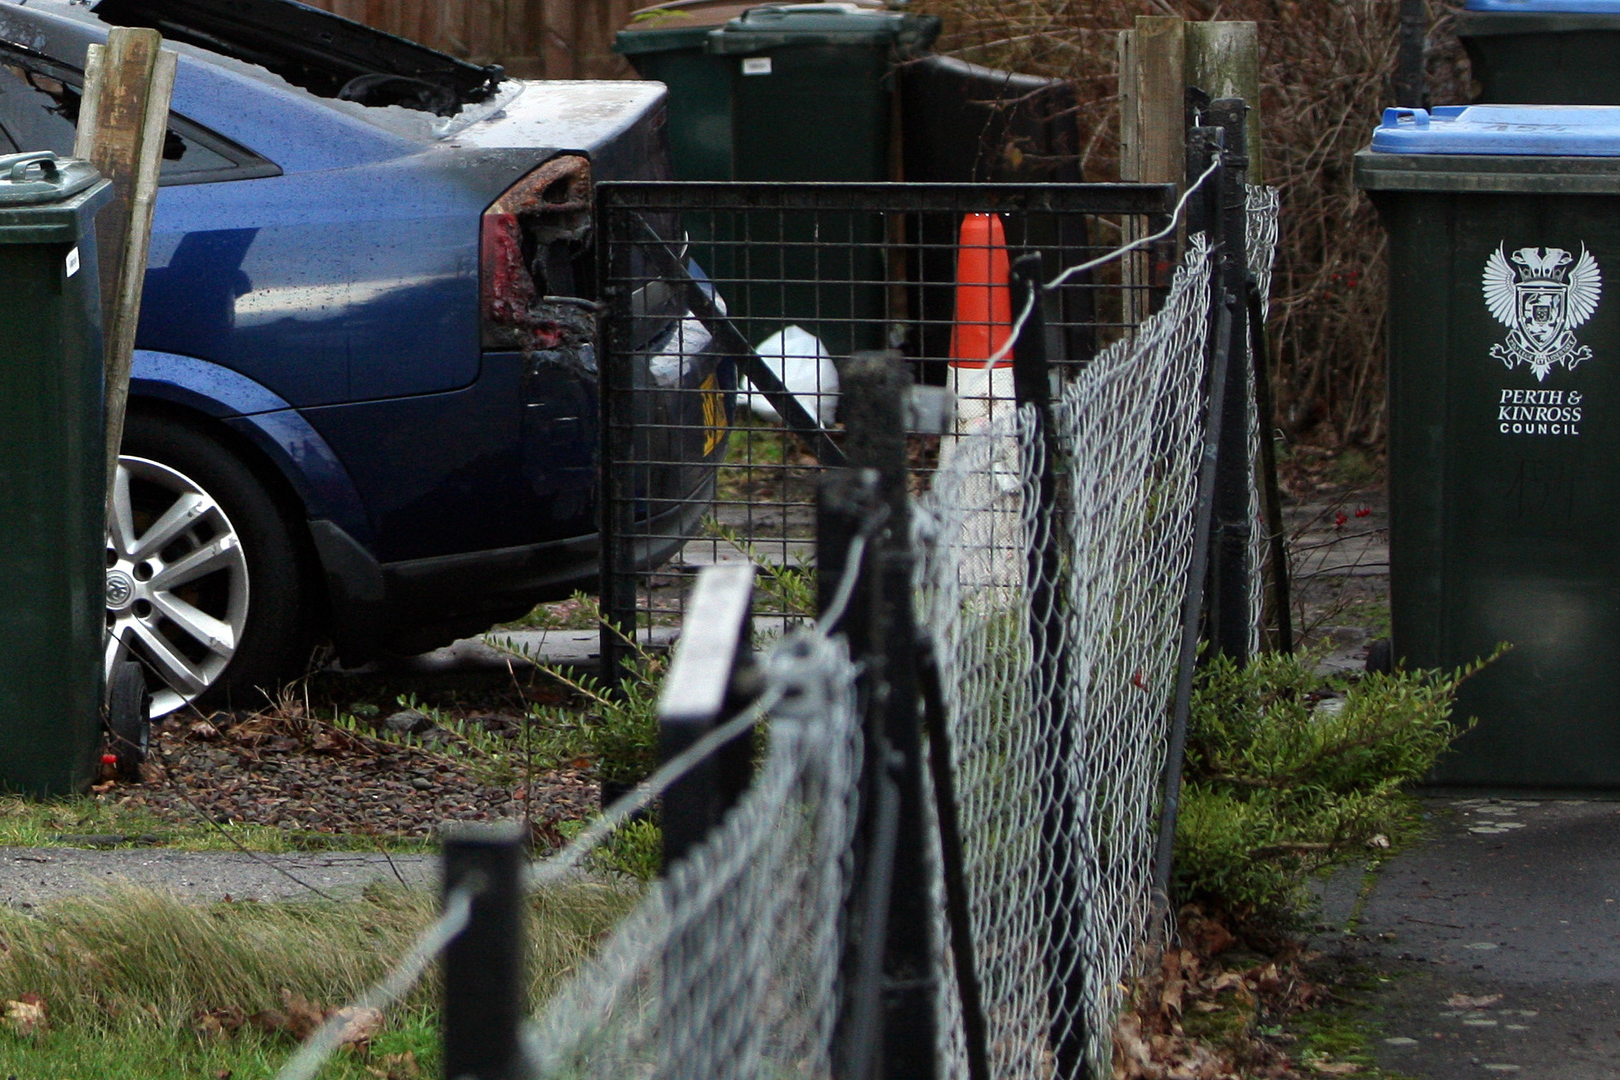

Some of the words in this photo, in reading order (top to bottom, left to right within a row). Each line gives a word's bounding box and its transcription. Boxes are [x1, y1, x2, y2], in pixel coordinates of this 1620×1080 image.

[1499, 389, 1562, 405] PERTH
[1567, 390, 1582, 405] &
[1497, 405, 1582, 421] KINROSS
[1500, 423, 1579, 435] COUNCIL
